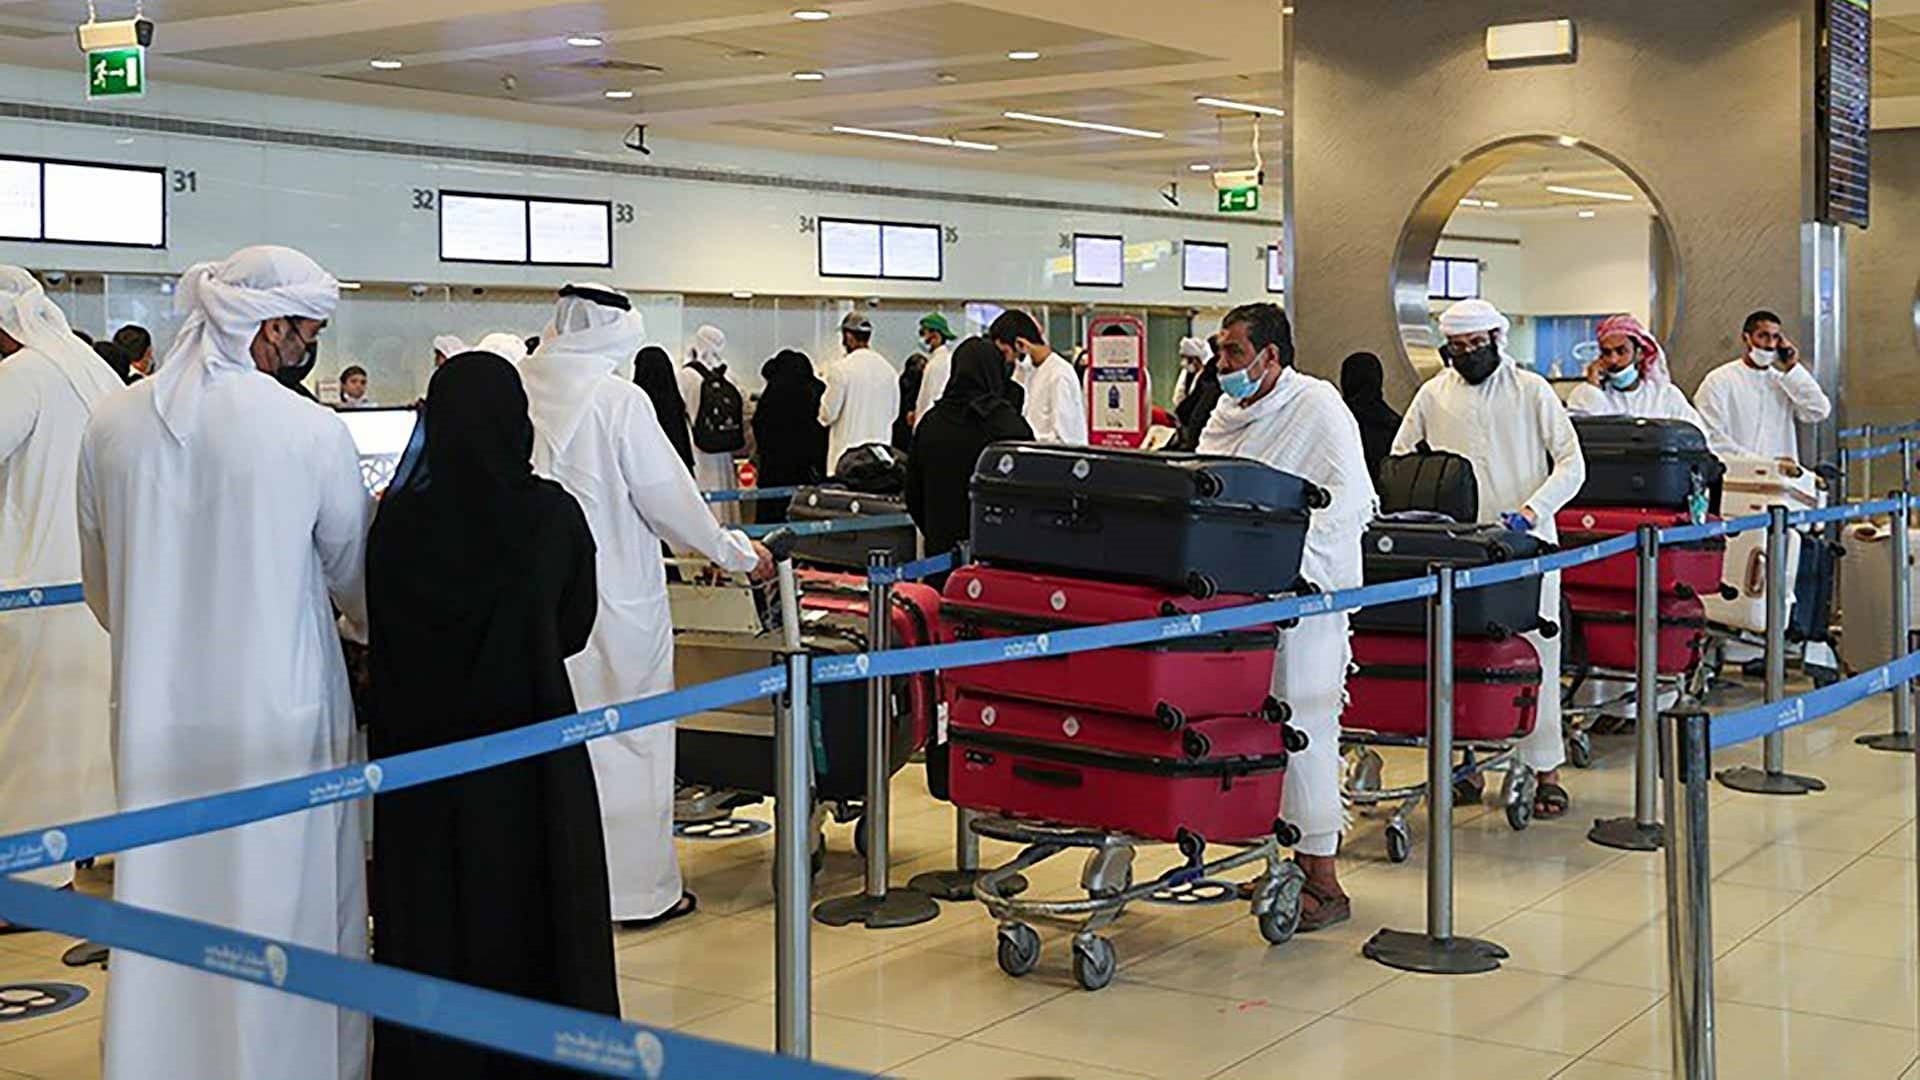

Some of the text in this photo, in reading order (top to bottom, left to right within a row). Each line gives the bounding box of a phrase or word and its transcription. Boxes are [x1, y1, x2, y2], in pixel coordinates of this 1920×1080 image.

[173, 170, 196, 192] 31
[412, 188, 434, 210] 32
[615, 203, 634, 223] 33
[944, 225, 958, 243] 35
